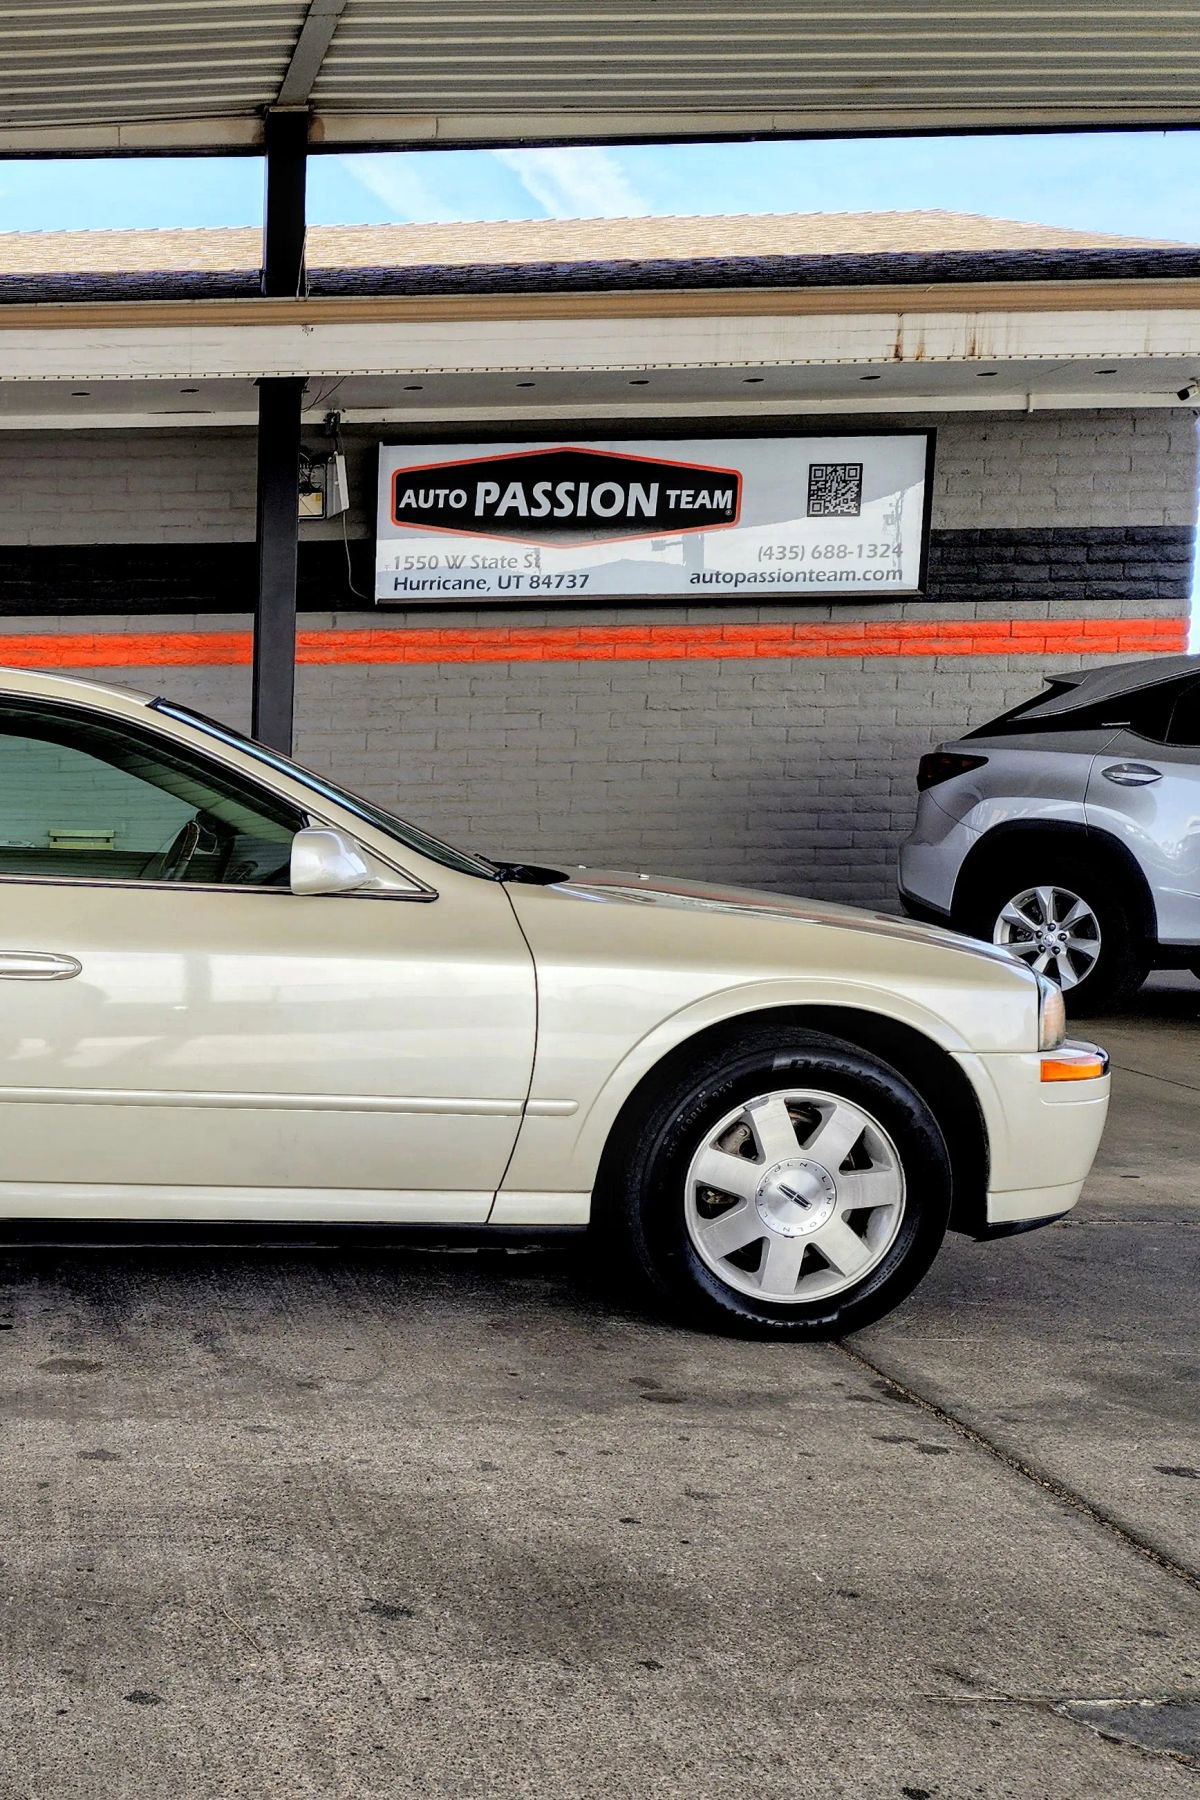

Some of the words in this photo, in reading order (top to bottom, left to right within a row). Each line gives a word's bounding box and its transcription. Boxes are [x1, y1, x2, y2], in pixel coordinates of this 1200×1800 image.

[398, 488, 468, 509] AUTO
[474, 481, 659, 517] PASSION
[666, 488, 733, 509] TEAM
[393, 554, 440, 571] 1550
[445, 554, 467, 570] W
[470, 553, 519, 570] State
[757, 544, 805, 562] (435)
[810, 543, 904, 560] 688-1324
[393, 575, 492, 592] Hurricane,
[497, 574, 525, 590] UT
[529, 573, 590, 590] 84737
[689, 567, 904, 588] autopassionteam.com
